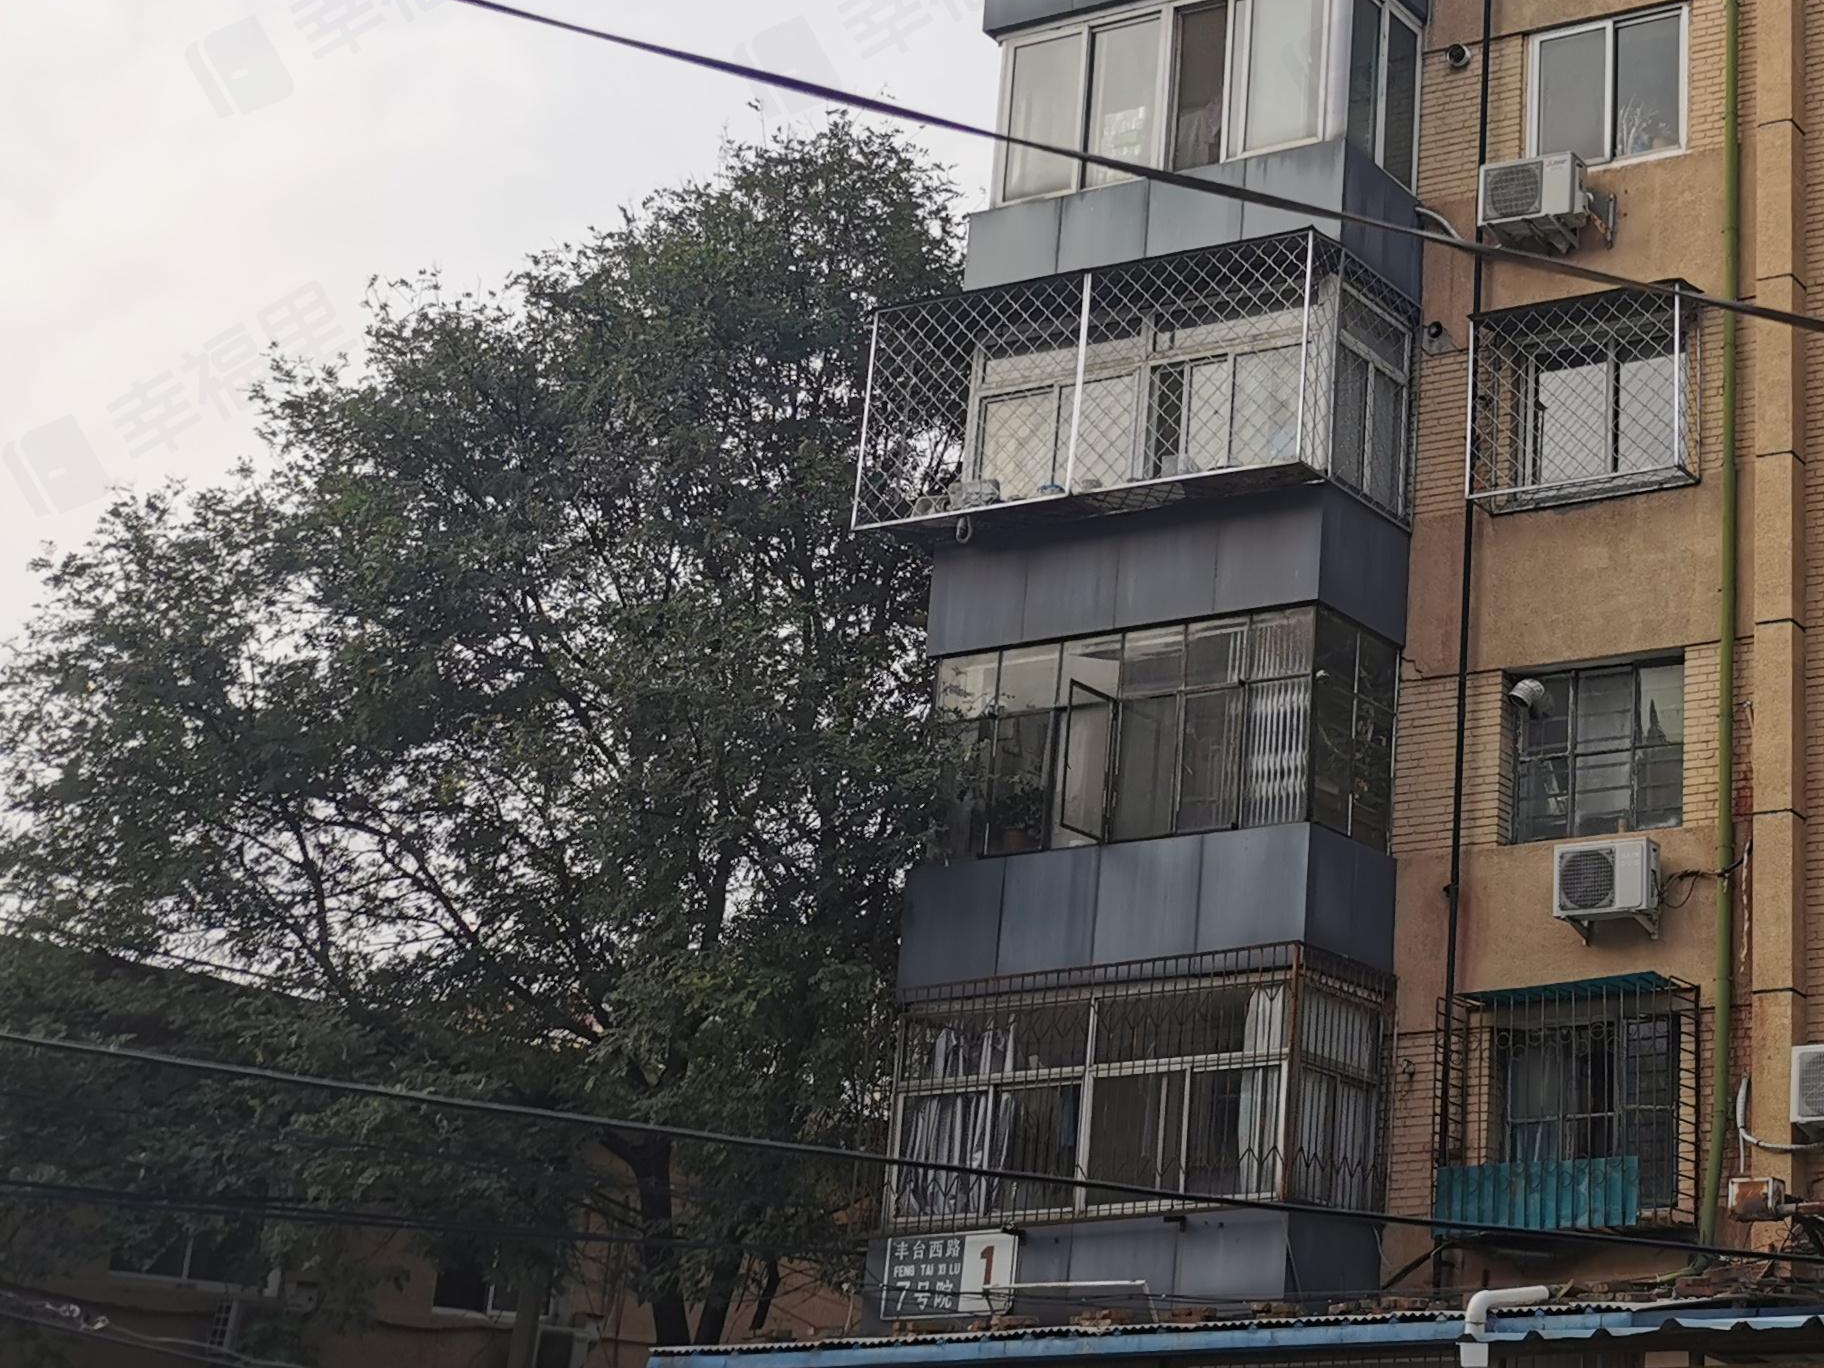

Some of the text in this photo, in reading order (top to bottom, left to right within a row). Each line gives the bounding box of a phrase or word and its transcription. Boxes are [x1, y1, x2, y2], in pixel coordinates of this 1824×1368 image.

[894, 1239, 961, 1260] 丰台西路
[893, 1262, 961, 1278] FENG TAI XI LU
[980, 1245, 995, 1285] 1
[895, 1279, 953, 1311] 7号院
